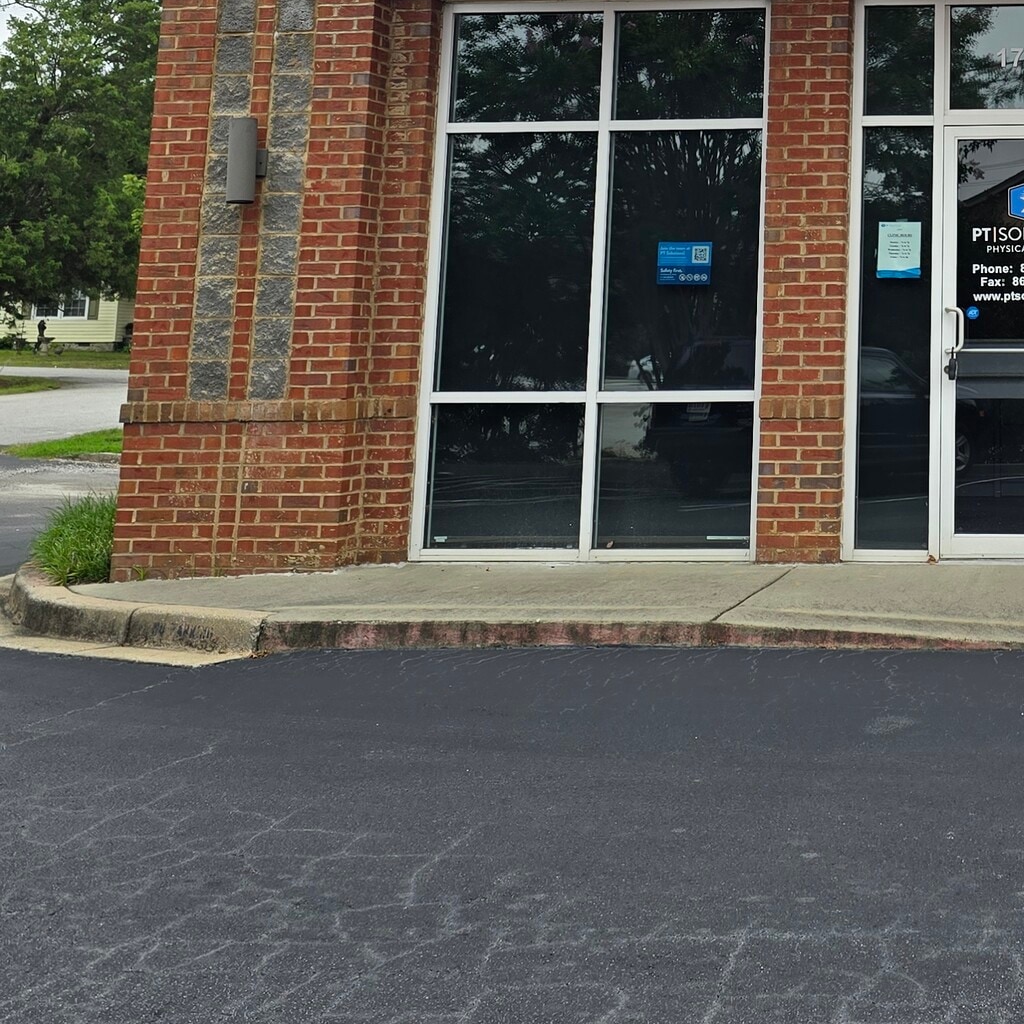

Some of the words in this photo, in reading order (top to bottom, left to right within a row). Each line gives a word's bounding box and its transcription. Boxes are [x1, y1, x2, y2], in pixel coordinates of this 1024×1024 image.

[972, 228, 991, 242] PT
[972, 263, 1014, 274] Phone:
[980, 277, 1006, 287] Fax:
